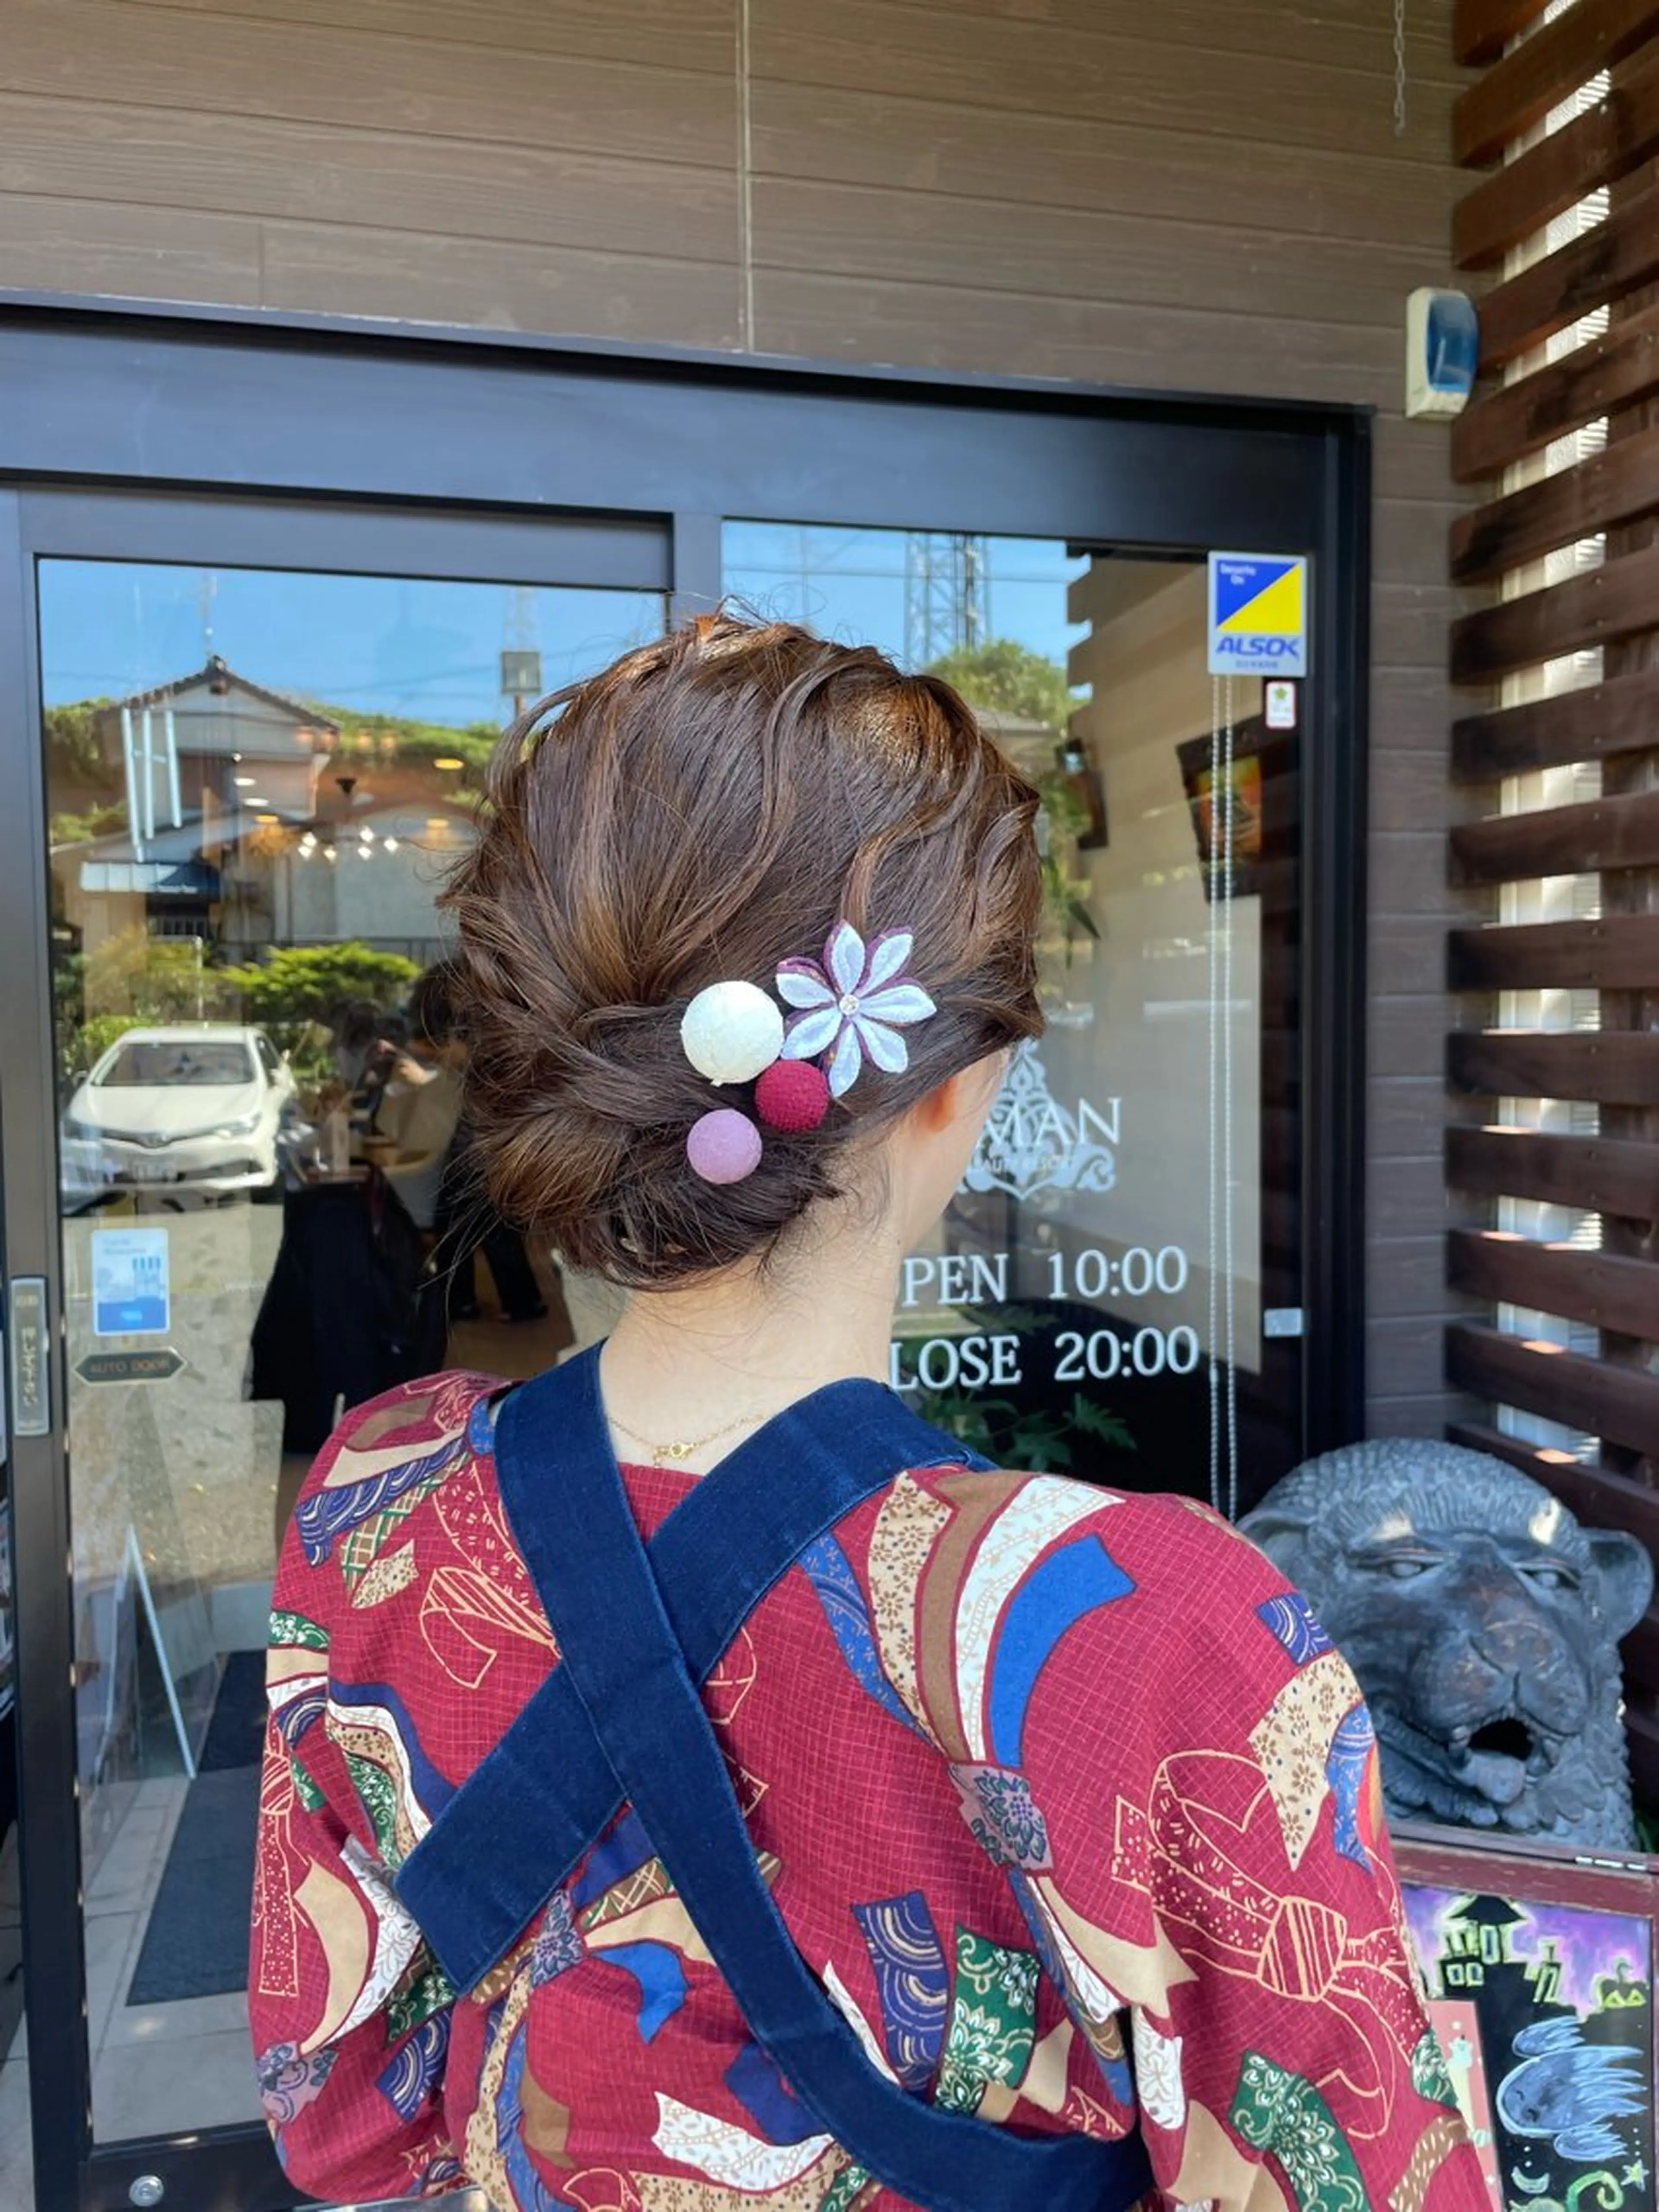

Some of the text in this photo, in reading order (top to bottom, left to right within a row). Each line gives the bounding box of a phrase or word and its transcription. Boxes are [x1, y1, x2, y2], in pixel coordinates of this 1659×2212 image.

[1216, 636, 1300, 661] ALSOK
[975, 1097, 1123, 1147] MAN
[901, 1246, 1188, 1307] PEN 10:00
[890, 1325, 1199, 1390] LOSE 20:00
